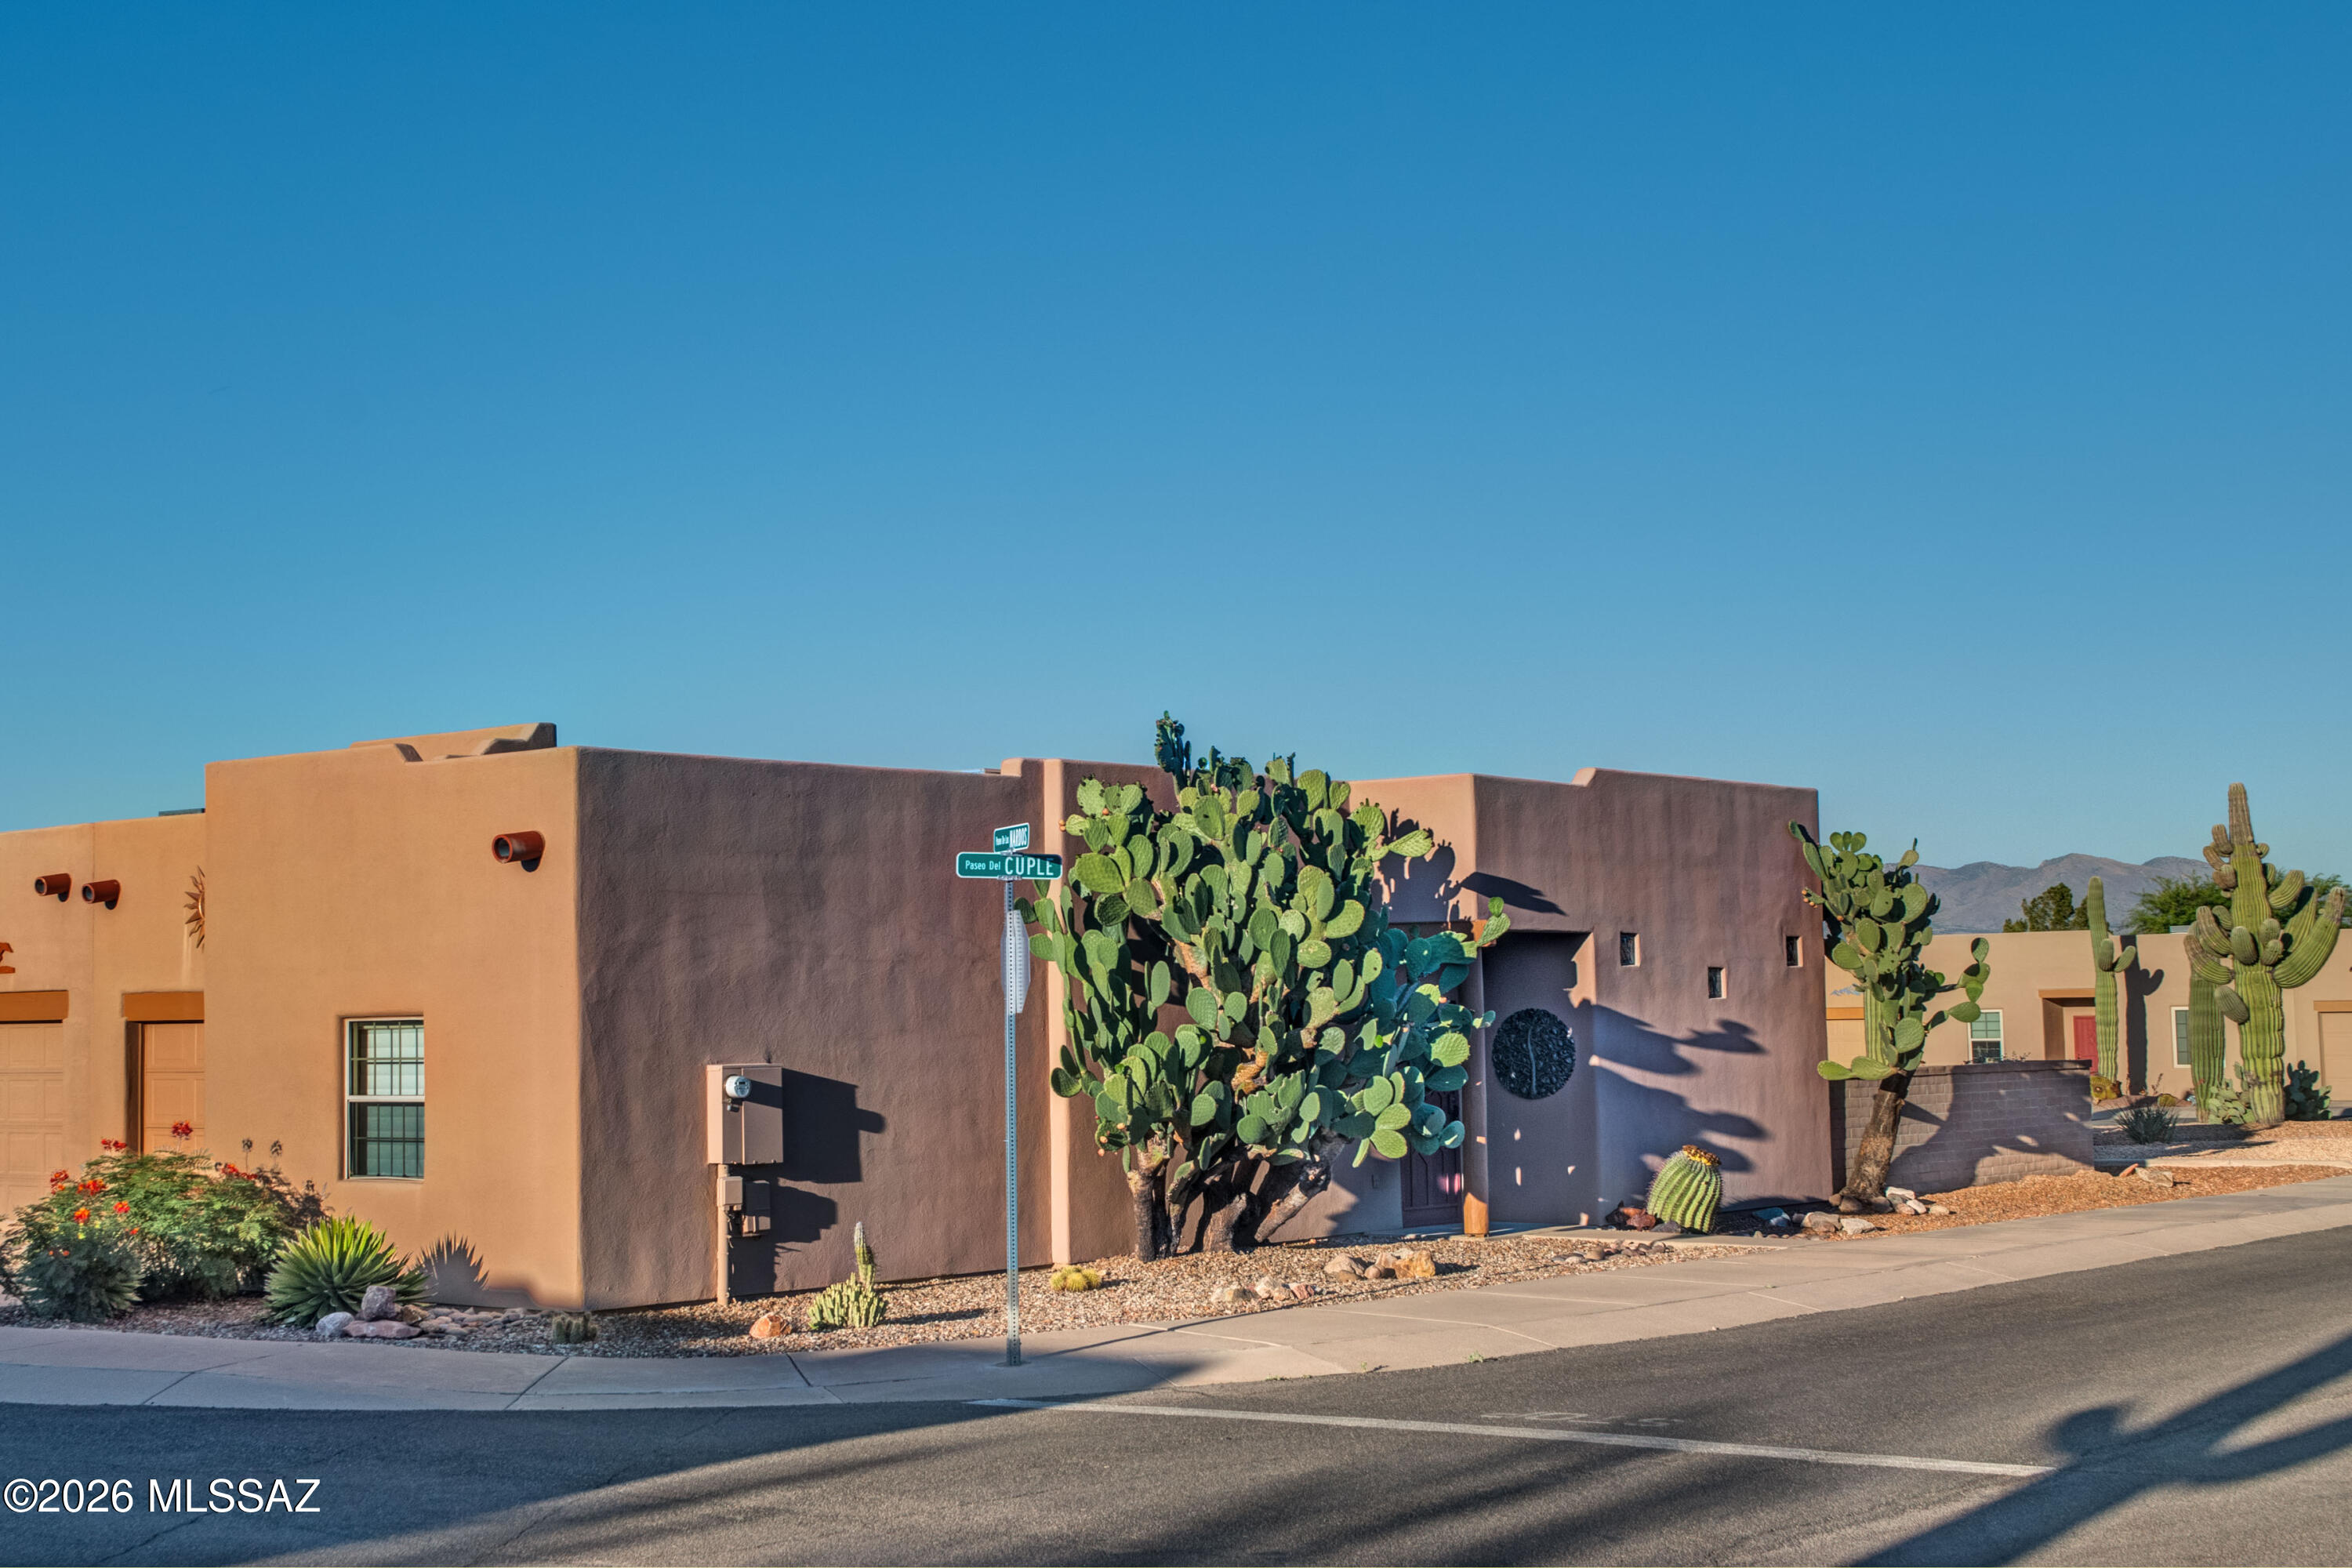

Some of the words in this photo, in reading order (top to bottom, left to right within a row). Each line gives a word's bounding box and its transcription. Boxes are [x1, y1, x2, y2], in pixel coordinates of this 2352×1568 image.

[965, 860, 985, 870] Paseo
[989, 861, 1000, 870] Del
[1004, 856, 1054, 876] CUPLE
